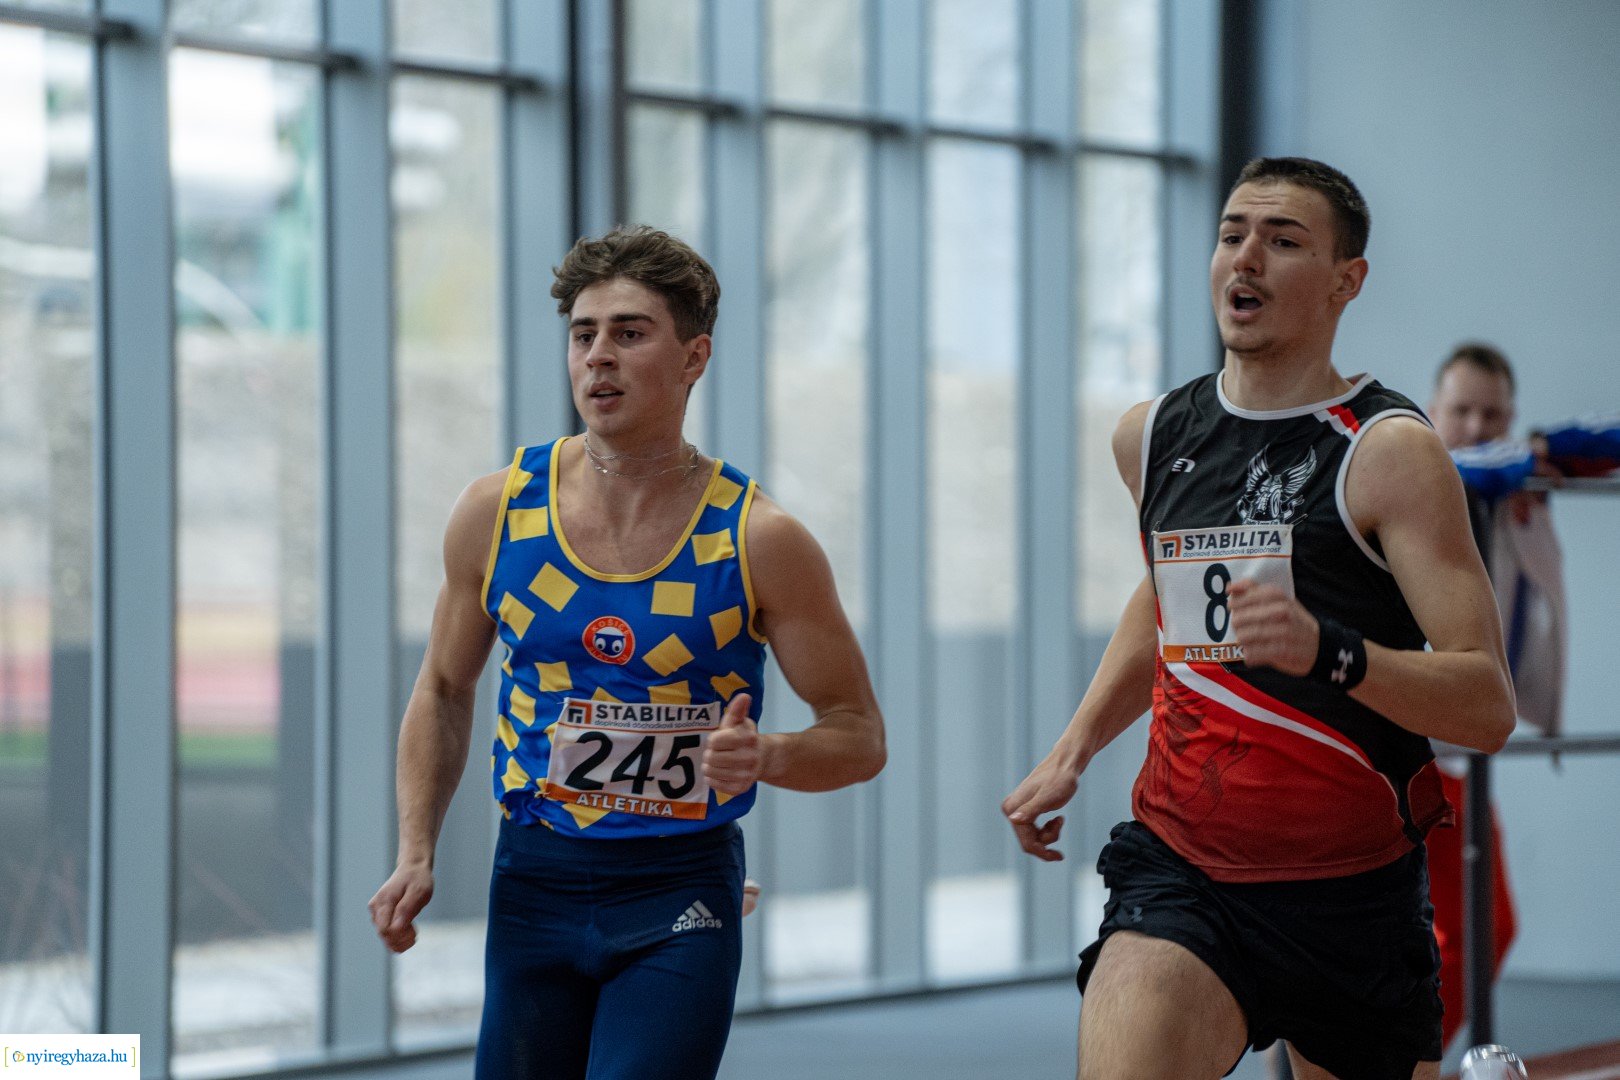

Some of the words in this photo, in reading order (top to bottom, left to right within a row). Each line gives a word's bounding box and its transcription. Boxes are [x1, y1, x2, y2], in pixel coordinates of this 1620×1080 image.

[1184, 530, 1282, 551] STABILITA
[1203, 563, 1232, 643] 8
[1184, 645, 1244, 661] ATLETIK
[595, 704, 711, 722] STABILITA
[565, 731, 700, 799] 245
[576, 793, 674, 817] ATLETIKA
[672, 916, 722, 932] adidas
